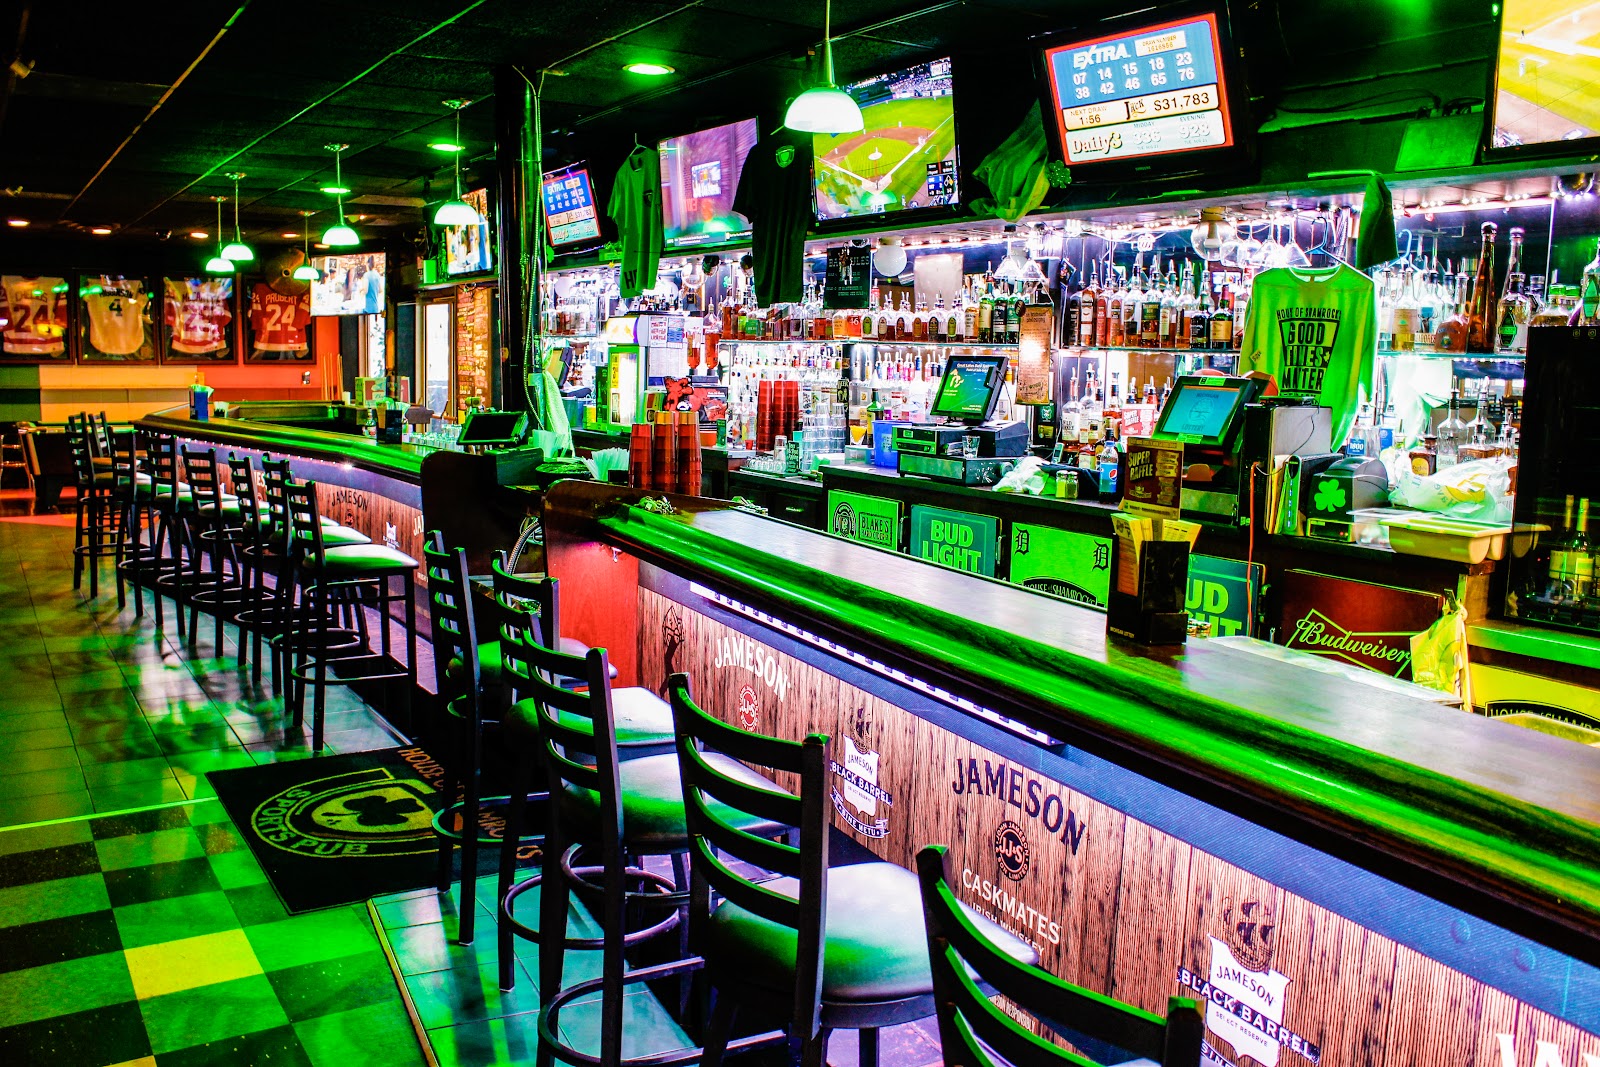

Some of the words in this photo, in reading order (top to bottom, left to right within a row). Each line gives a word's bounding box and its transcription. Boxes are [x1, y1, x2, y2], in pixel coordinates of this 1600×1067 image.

[1073, 43, 1128, 70] EXTRA
[1073, 72, 1087, 85] 07
[1098, 67, 1113, 80] 14
[1122, 63, 1138, 76] 15
[1149, 57, 1165, 71] 18
[1175, 52, 1193, 66] 23
[1075, 86, 1090, 100] 38
[1100, 82, 1115, 95] 42
[1125, 78, 1140, 91] 46
[1150, 72, 1167, 86] 65
[1177, 67, 1195, 81] 76
[1080, 114, 1101, 126] 1:56
[13, 304, 50, 333] 24
[108, 298, 122, 317] 4
[265, 304, 297, 331] 24
[1288, 322, 1326, 345] GOOD
[1128, 451, 1151, 468] SUPER
[1130, 464, 1154, 480] RAFFLE
[331, 489, 369, 512] JAMESON
[931, 519, 974, 548] BUD
[922, 540, 982, 573] LIGHT
[1296, 618, 1412, 664] Budweiser
[714, 636, 788, 703] JAMESON
[398, 748, 445, 779] HOUSE
[848, 754, 874, 776] JAMESON
[832, 761, 857, 785] BLACK
[859, 777, 893, 804] BARREL
[258, 789, 311, 841] SPORTS
[290, 838, 369, 855] PUB
[951, 758, 1087, 856] JAMESON
[962, 868, 1061, 945] CASKMATES
[973, 902, 998, 924] IRISH
[1000, 920, 1045, 957] WHISKEY
[1216, 965, 1277, 1007] JAMESON
[1181, 969, 1238, 1013] BLACK
[1241, 1005, 1314, 1060] BARREL
[1239, 1025, 1269, 1048] RESERVE
